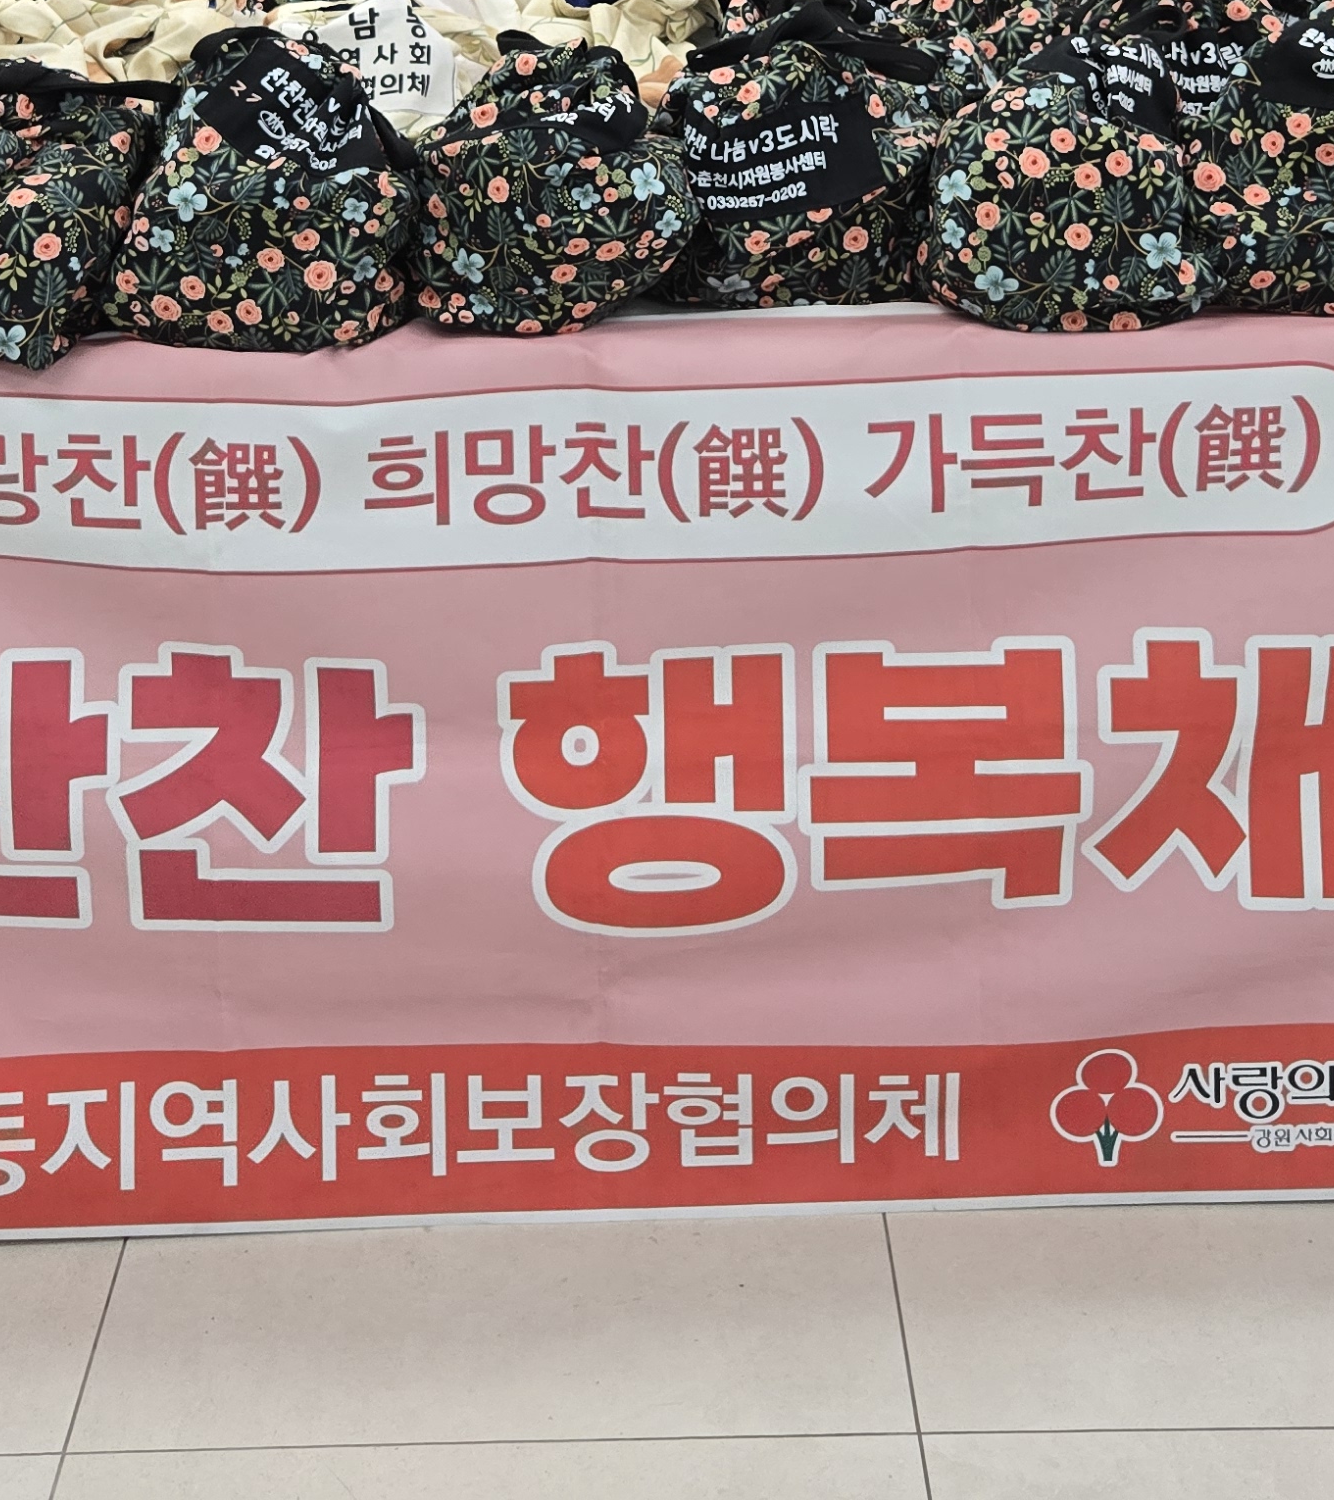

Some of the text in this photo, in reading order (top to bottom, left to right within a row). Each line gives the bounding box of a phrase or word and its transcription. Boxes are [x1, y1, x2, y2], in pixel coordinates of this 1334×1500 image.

[710, 113, 840, 163] 나눔v3도시락
[697, 150, 827, 190] 춘천시자원봉사센터
[707, 181, 808, 210] 033)257-0202
